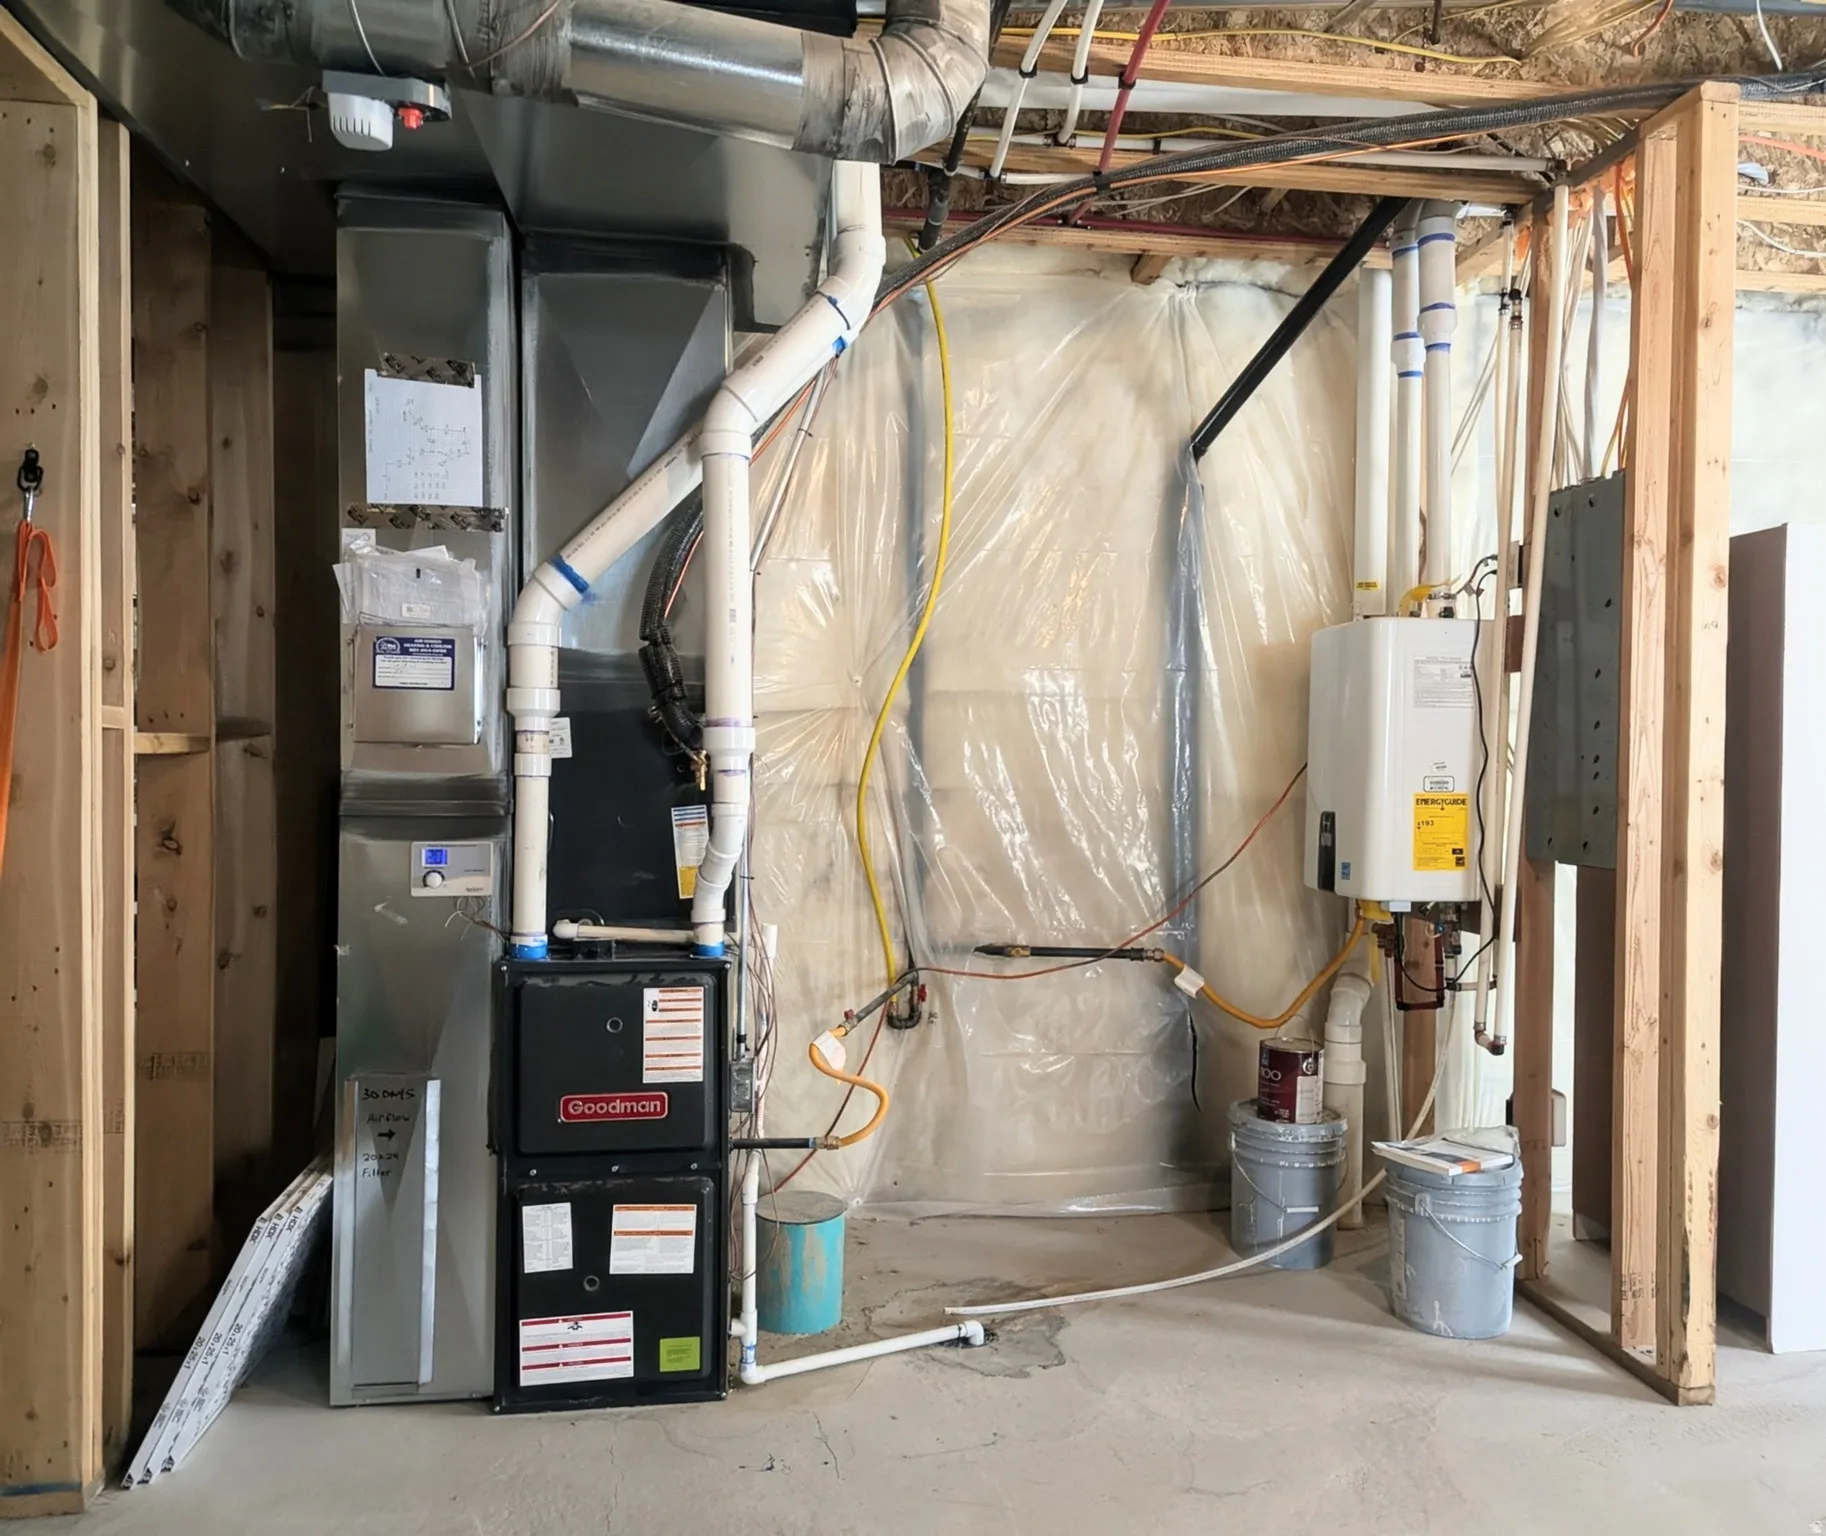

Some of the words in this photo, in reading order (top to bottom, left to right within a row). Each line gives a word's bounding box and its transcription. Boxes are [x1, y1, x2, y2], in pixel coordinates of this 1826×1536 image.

[568, 1098, 661, 1115] Goodman
[362, 1168, 392, 1178] Filter
[265, 1223, 279, 1240] HDX
[286, 1215, 299, 1232] HDX
[249, 1226, 263, 1244] HDX
